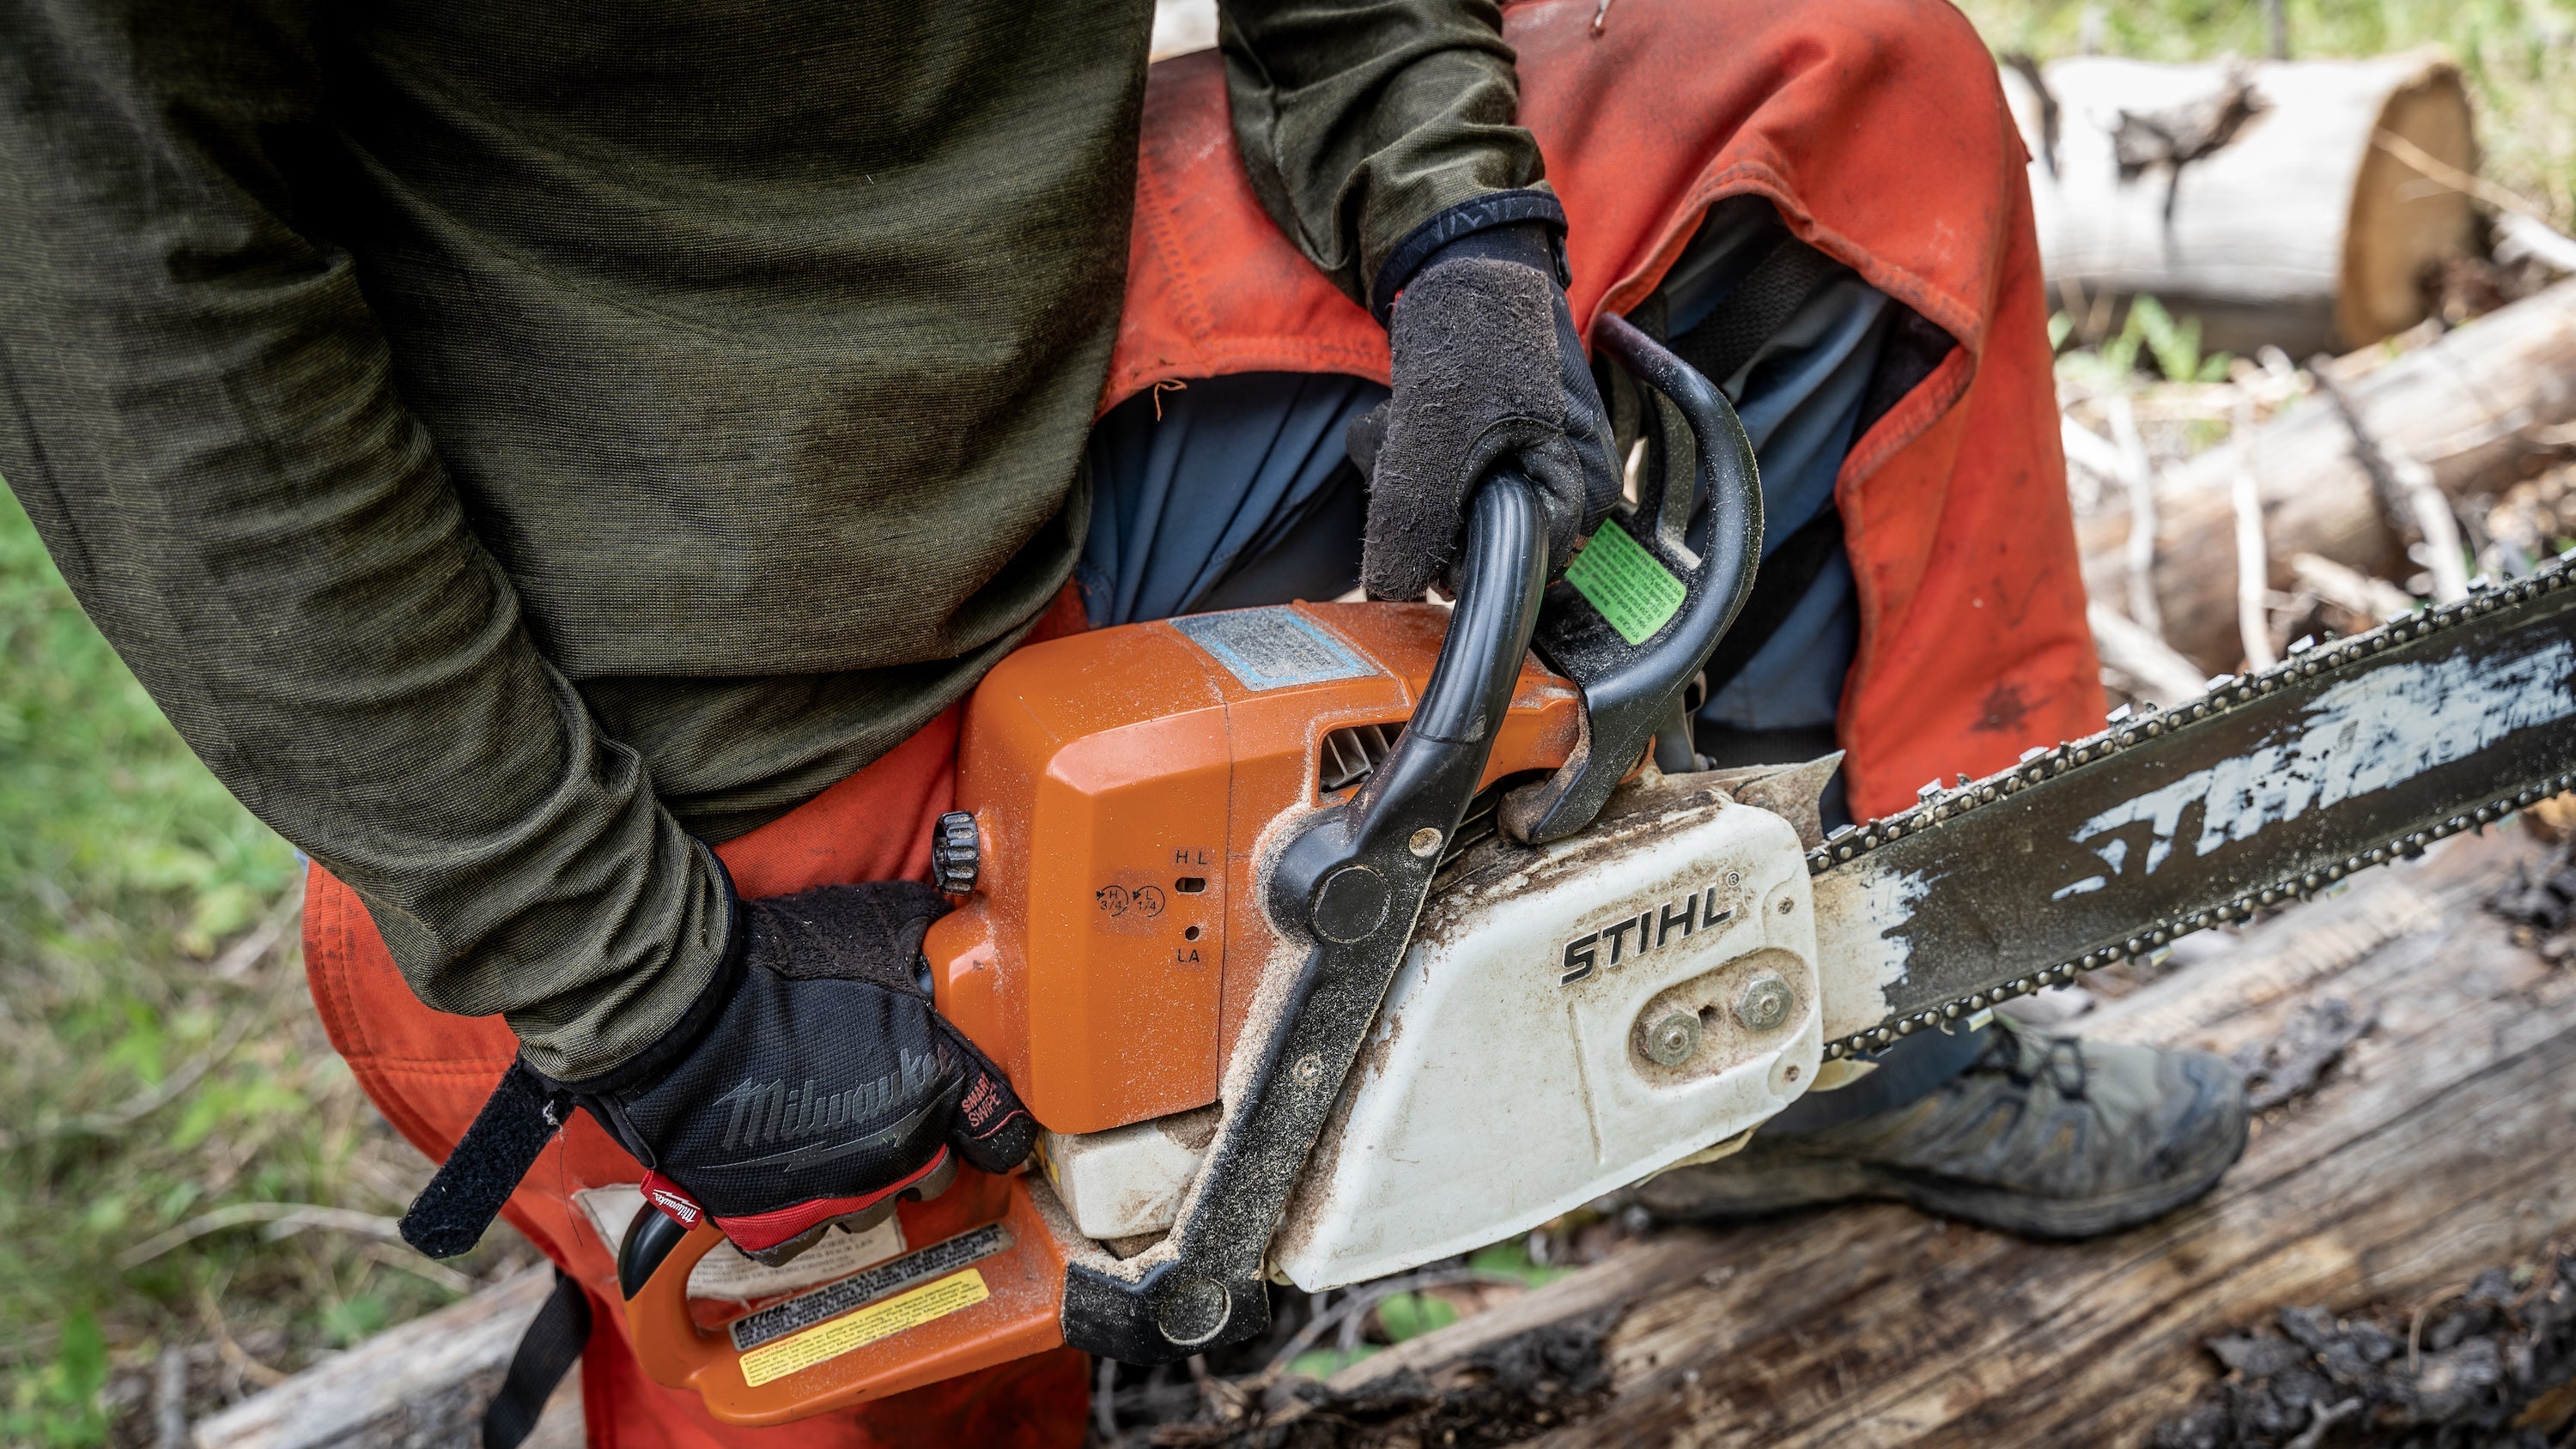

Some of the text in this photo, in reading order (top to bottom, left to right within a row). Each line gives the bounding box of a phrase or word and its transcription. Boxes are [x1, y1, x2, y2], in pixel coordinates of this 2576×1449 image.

[1176, 850, 1207, 865] H L
[1109, 890, 1118, 900] H
[1145, 890, 1153, 900] L
[1100, 901, 1122, 911] 3/4
[1137, 901, 1157, 911] 1/4
[1558, 883, 1737, 988] STIHL
[1177, 949, 1200, 963] LA
[714, 1044, 956, 1151] Milwaukee
[961, 1071, 991, 1113] SMART
[968, 1089, 1002, 1128] SWIPE
[653, 1191, 696, 1223] Milwaukee
